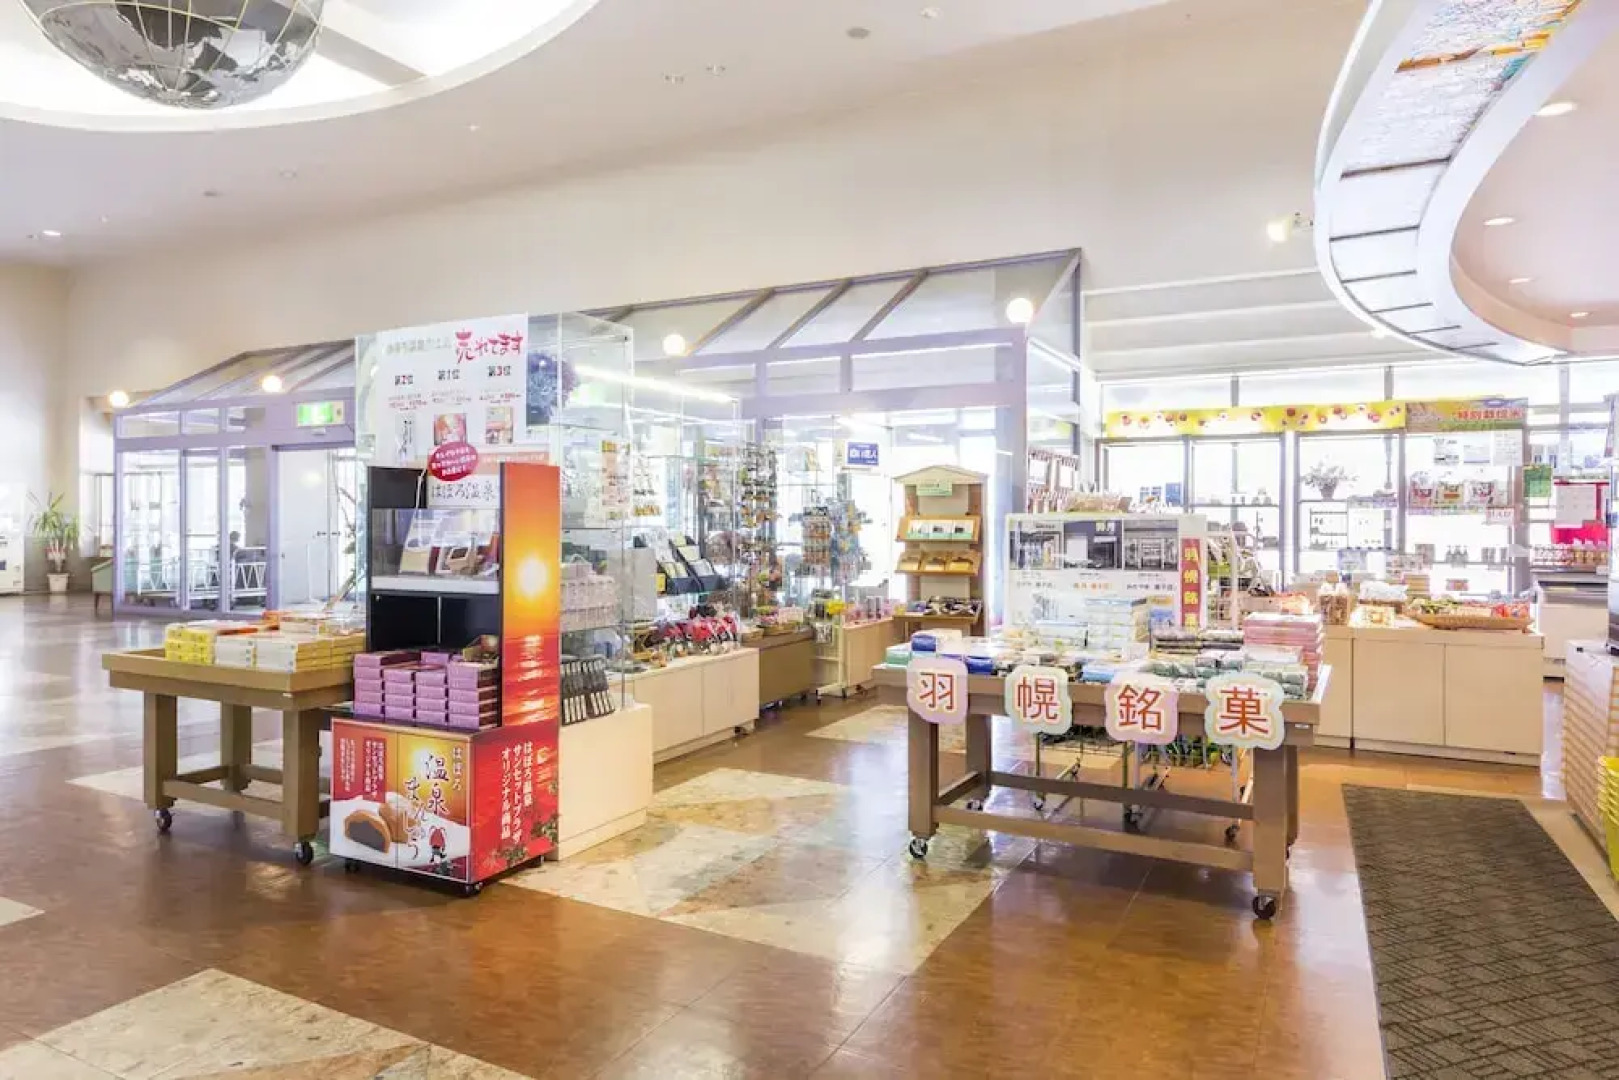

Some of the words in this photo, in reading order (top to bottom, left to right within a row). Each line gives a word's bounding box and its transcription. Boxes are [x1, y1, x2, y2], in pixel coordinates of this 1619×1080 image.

[455, 327, 523, 364] 売れてます
[431, 481, 496, 502] はぼろ温泉
[919, 671, 955, 712] 羽
[1015, 677, 1059, 721] 幌
[1117, 683, 1163, 732] 銘
[1218, 685, 1271, 735] 菓
[424, 753, 450, 817] 温泉
[452, 746, 463, 791] はぼろ
